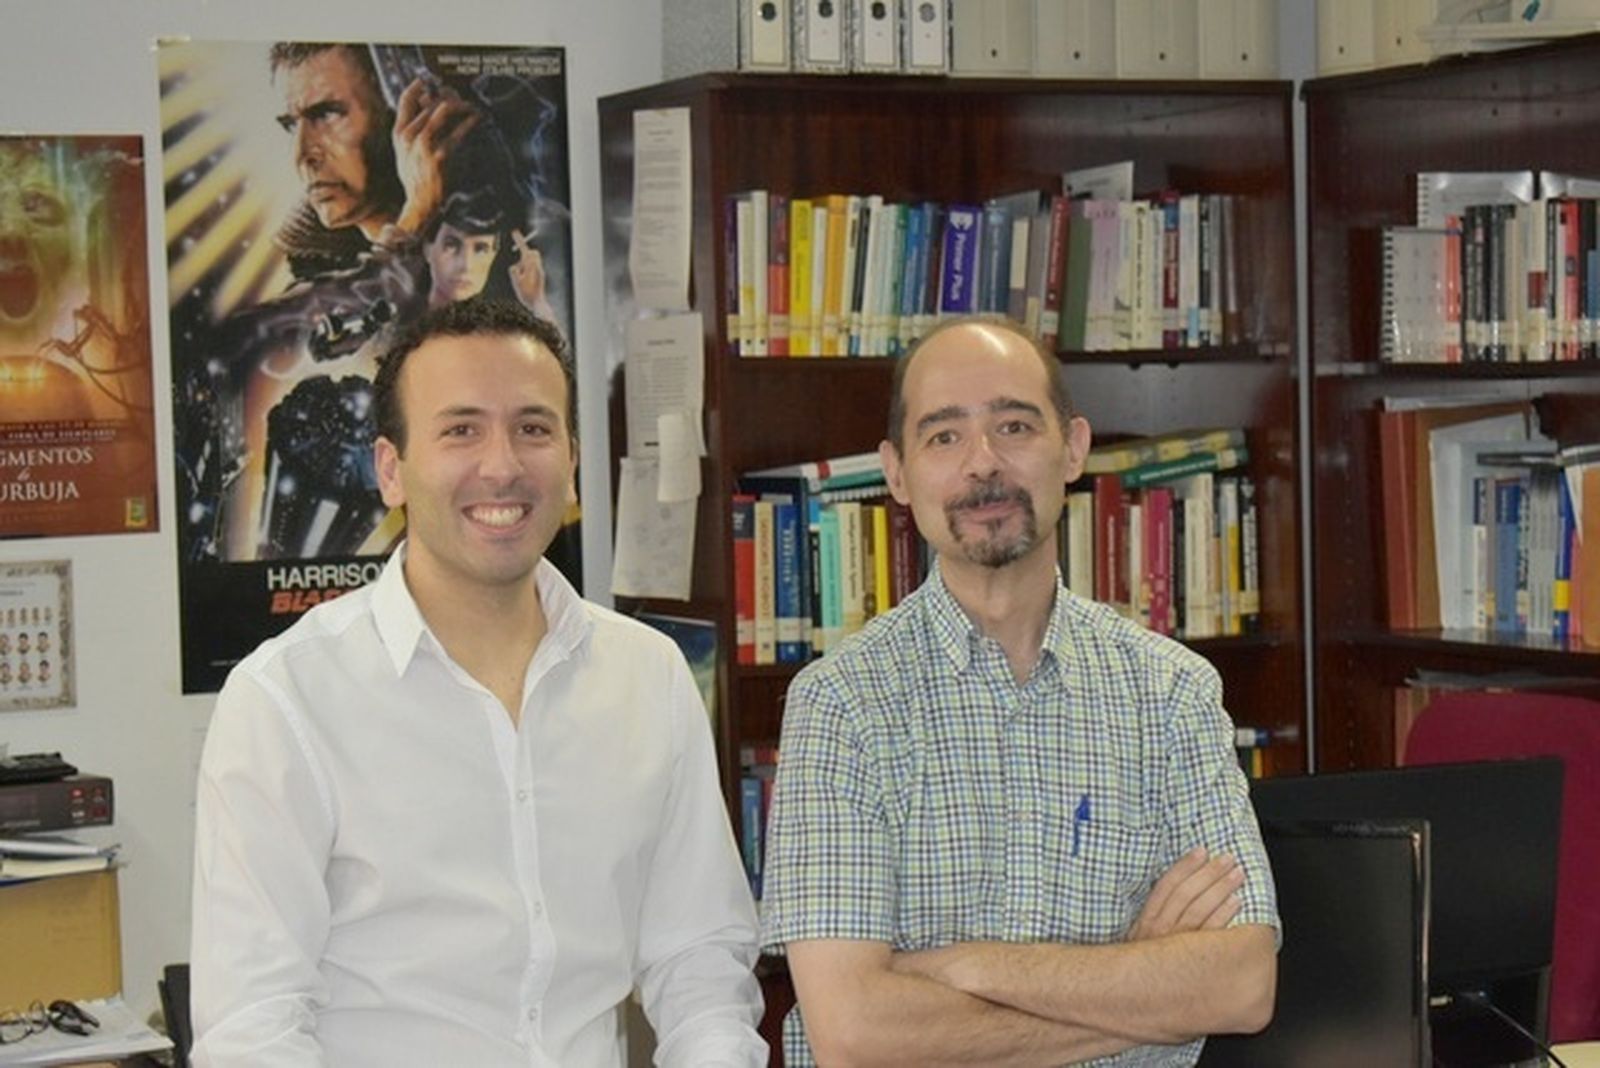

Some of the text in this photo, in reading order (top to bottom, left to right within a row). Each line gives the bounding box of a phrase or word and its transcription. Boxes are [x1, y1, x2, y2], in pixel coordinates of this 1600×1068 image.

[0, 481, 79, 502] URBUJA
[267, 562, 388, 590] HARRISO
[271, 590, 351, 613] BLA
